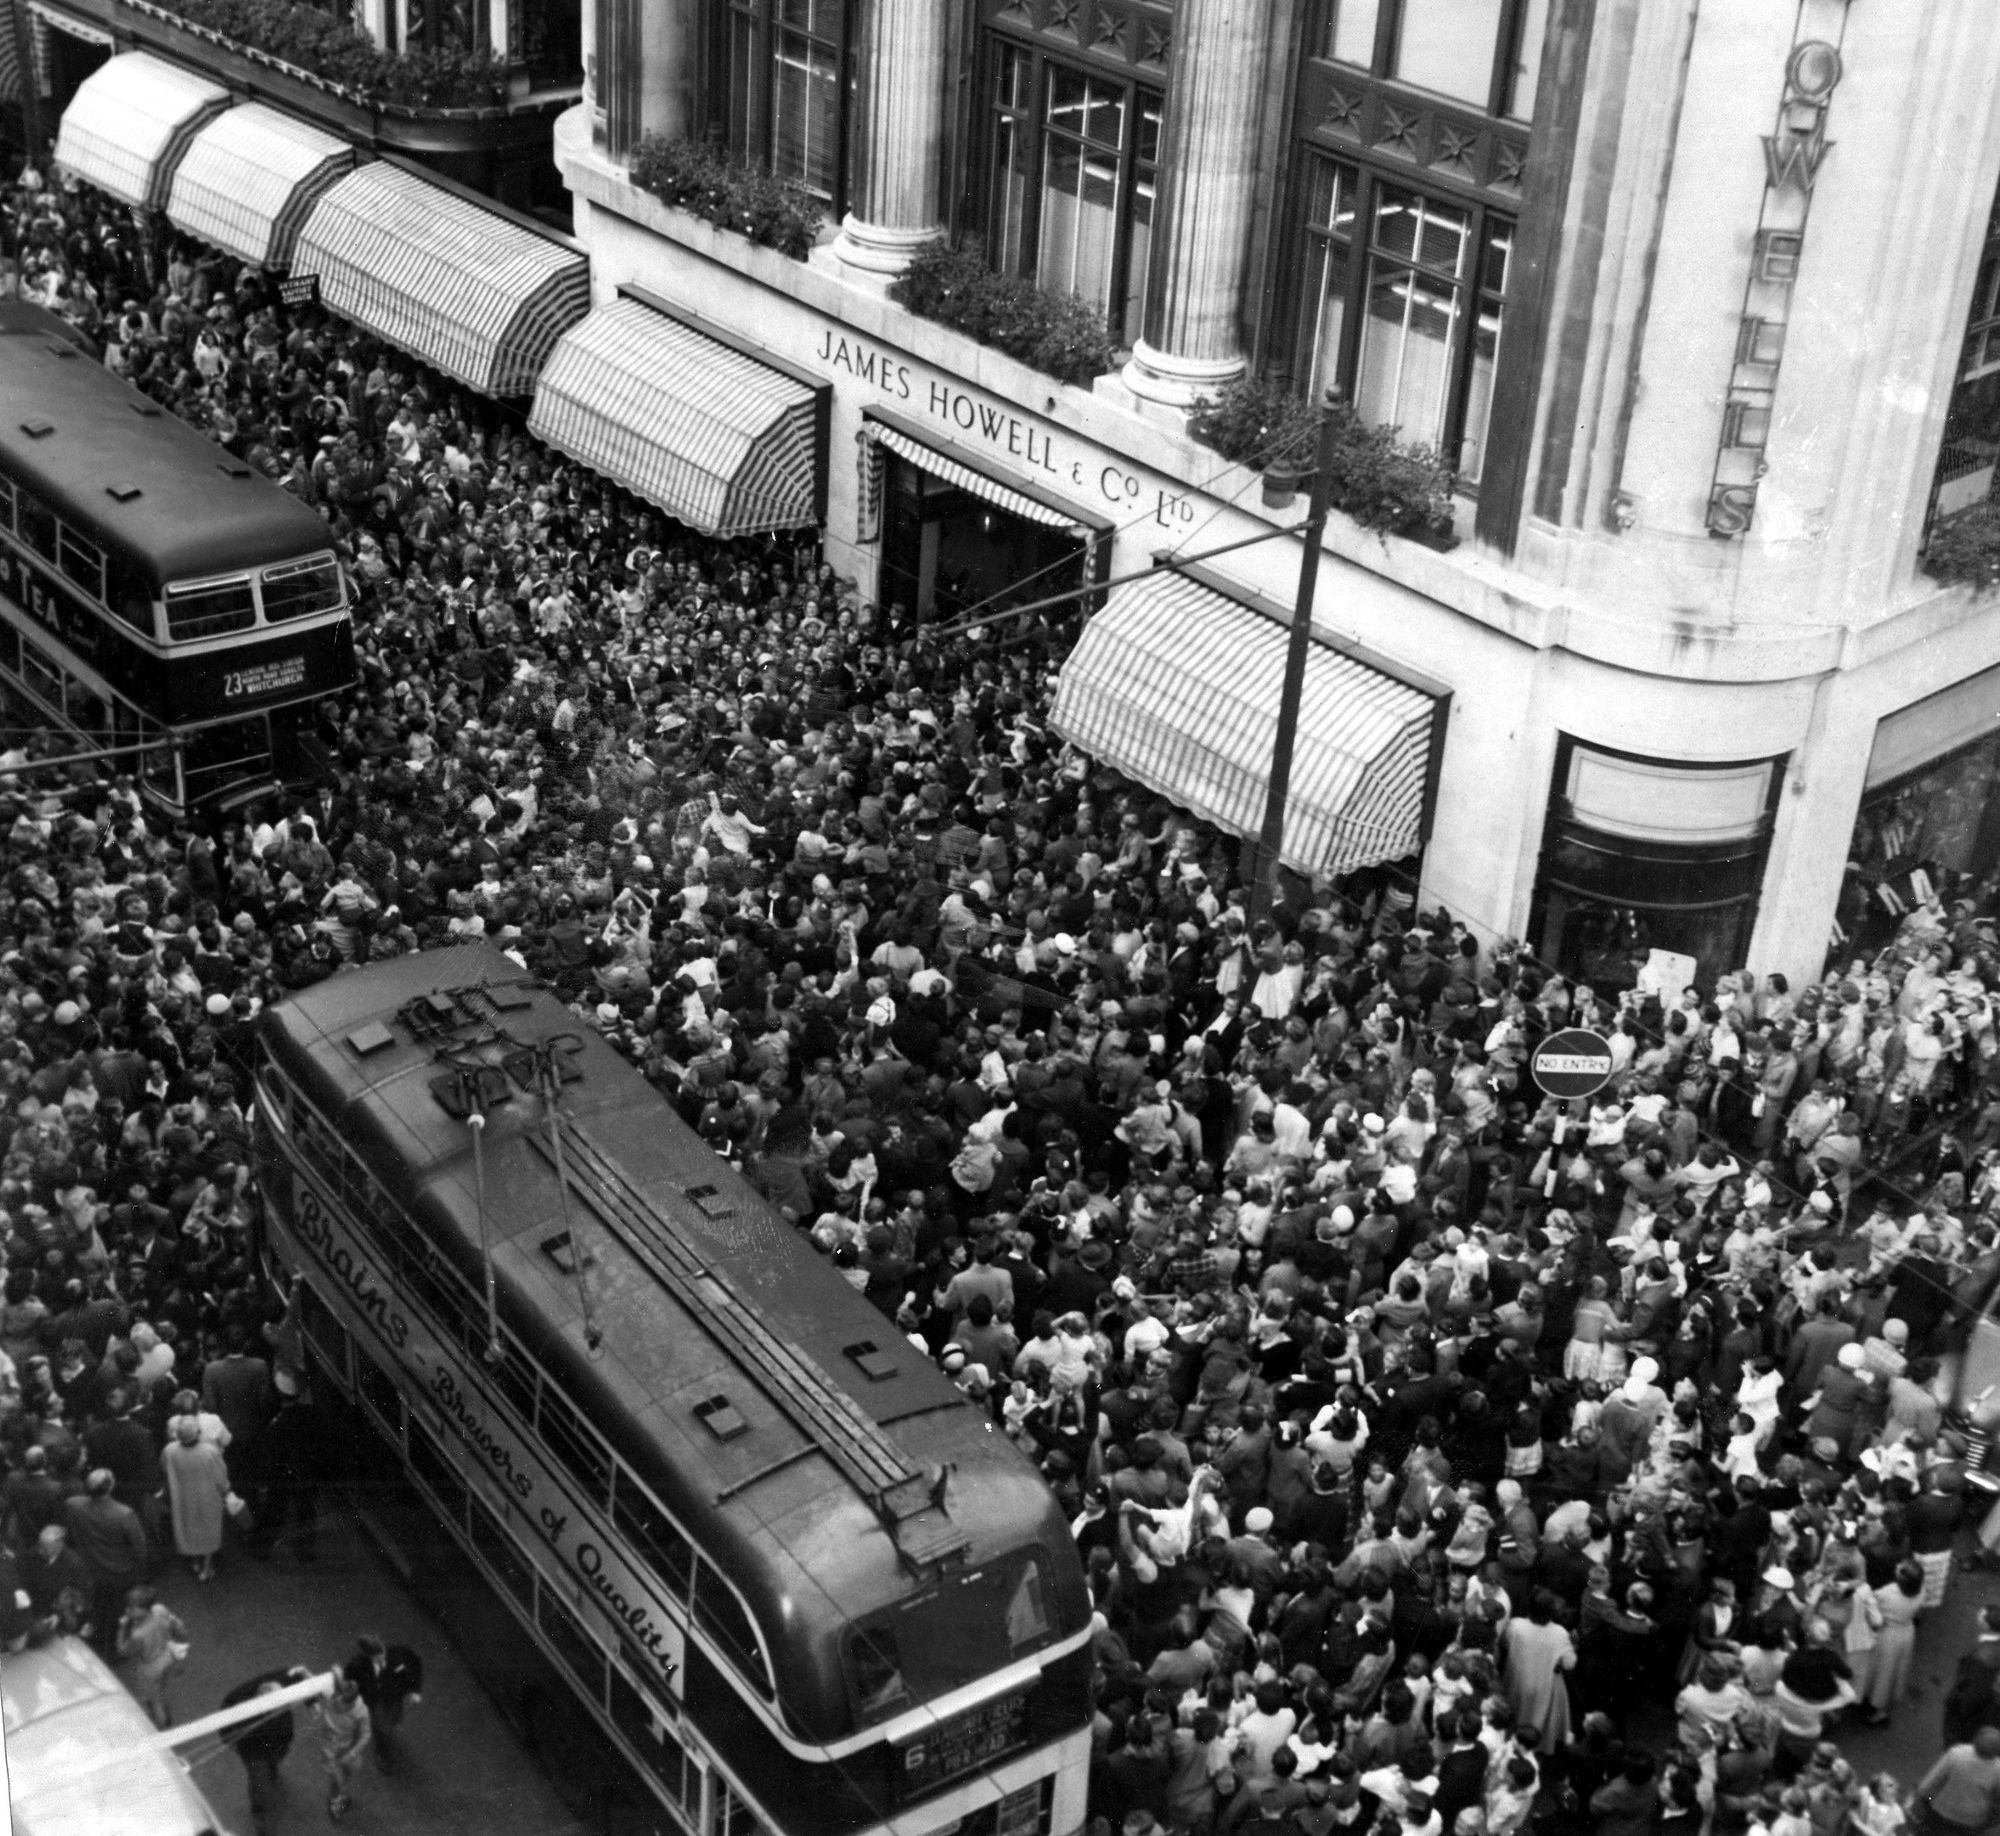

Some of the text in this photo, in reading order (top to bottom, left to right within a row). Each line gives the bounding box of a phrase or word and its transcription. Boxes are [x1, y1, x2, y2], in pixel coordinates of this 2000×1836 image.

[817, 331, 910, 399] JAMES
[930, 381, 1057, 472] HOWELL
[16, 559, 61, 632] TEA
[224, 672, 242, 696] 23
[247, 672, 303, 693] WHITCHURCH
[1540, 1059, 1605, 1069] NO ENTRY
[302, 1191, 409, 1348] Brains
[431, 1366, 533, 1498] Brewers
[540, 1508, 568, 1543] of
[577, 1543, 679, 1684] Quality
[905, 1743, 925, 1771] 6
